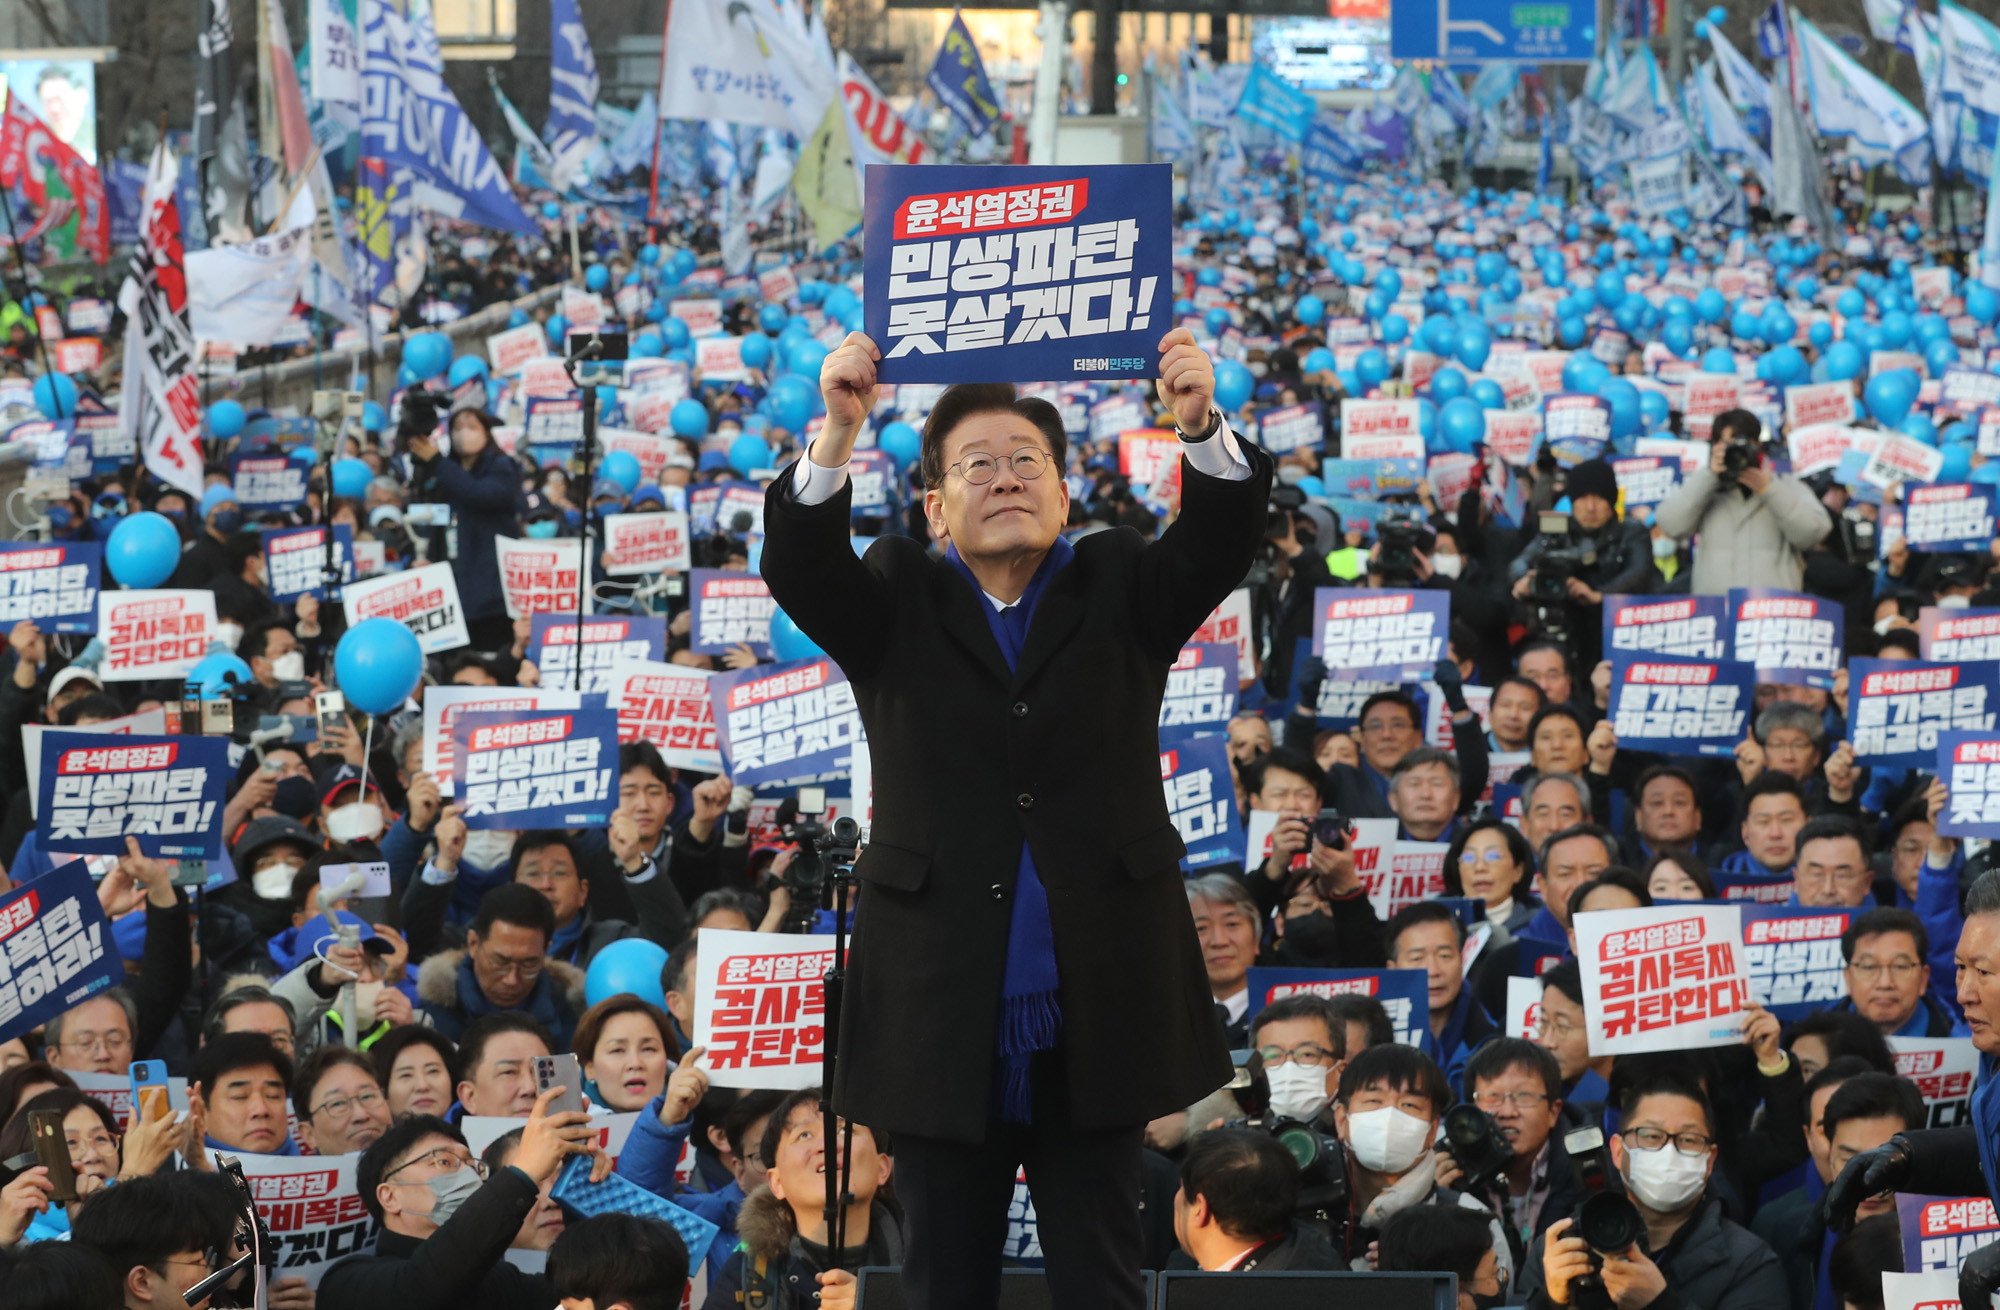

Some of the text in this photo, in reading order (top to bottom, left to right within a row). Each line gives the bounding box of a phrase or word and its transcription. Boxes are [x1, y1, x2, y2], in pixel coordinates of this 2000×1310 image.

[906, 184, 1074, 233] 윤석열정권
[888, 219, 1139, 299] 민생파탄
[885, 276, 1158, 358] 못살겠다!
[1073, 357, 1146, 371] 더불어민주당
[110, 613, 205, 646] 검사독재
[1323, 612, 1436, 644] 민생파탄
[1735, 617, 1834, 647] 민생파탄
[733, 665, 822, 707] 윤석열정권
[1619, 684, 1741, 711] 물가폭탄
[1866, 669, 1952, 695] 윤석열정권
[1614, 710, 1746, 738] 해결하라!
[1856, 685, 1988, 728] 물가폭탄
[475, 718, 566, 748] 윤석열정권
[65, 745, 170, 772] 윤석열정권
[466, 737, 602, 785] 민생파탄
[53, 767, 208, 807] 민생파탄
[465, 768, 612, 817] 못살겠다!
[49, 801, 216, 840] 못살겠다!
[1606, 918, 1701, 959] 윤석열정권
[1750, 916, 1842, 942] 윤석열정권
[1600, 942, 1735, 1000] 검사독재
[1602, 978, 1747, 1039] 규탄한다!
